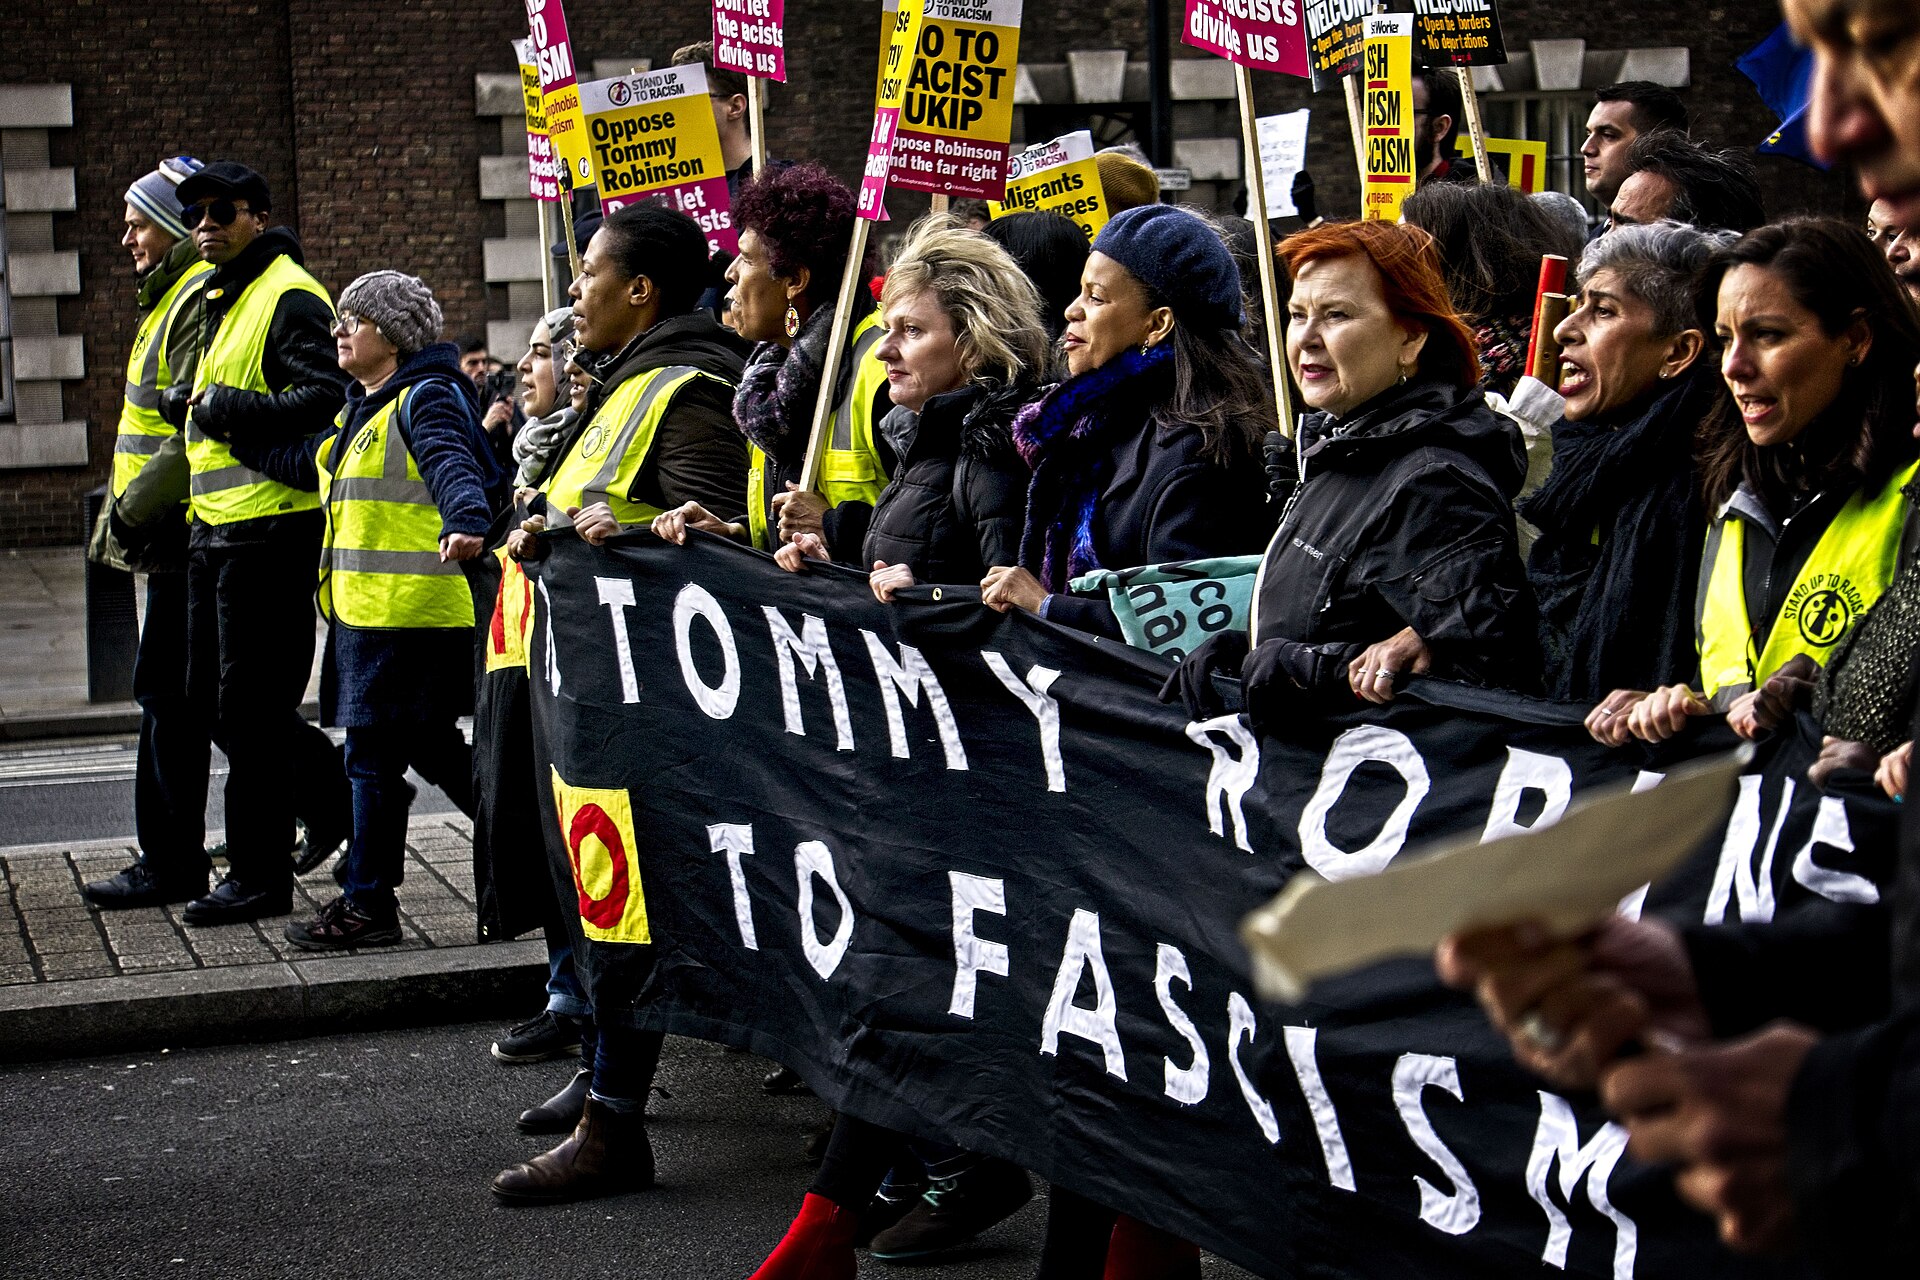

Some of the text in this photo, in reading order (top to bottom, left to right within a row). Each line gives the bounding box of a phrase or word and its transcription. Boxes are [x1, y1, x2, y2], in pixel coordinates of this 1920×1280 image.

[716, 11, 738, 38] the
[936, 5, 992, 21] TO RACISM
[1456, 13, 1492, 31] borders
[954, 28, 999, 64] TO
[1190, 1, 1280, 62] divide us
[756, 52, 777, 74] us
[632, 72, 678, 91] STAND UP
[633, 83, 686, 102] TO RACISM
[906, 57, 1008, 101] ACIST
[904, 91, 984, 132] UKIP
[591, 111, 677, 145] Oppose
[595, 136, 677, 167] Tommy
[934, 138, 1003, 162] Robinson
[1021, 147, 1048, 163] STAND
[1035, 151, 1069, 169] RACISM
[601, 157, 705, 193] Robinson
[910, 155, 934, 173] the
[936, 159, 959, 176] far
[961, 163, 998, 182] right
[674, 185, 706, 212] let
[1000, 172, 1084, 212] Migrants
[1783, 583, 1809, 620] STAND
[1809, 574, 1824, 590] UP
[1828, 573, 1841, 588] TO
[594, 575, 1066, 794] TOMMY
[706, 822, 855, 981] TO
[947, 869, 1637, 1280] FASCISM
